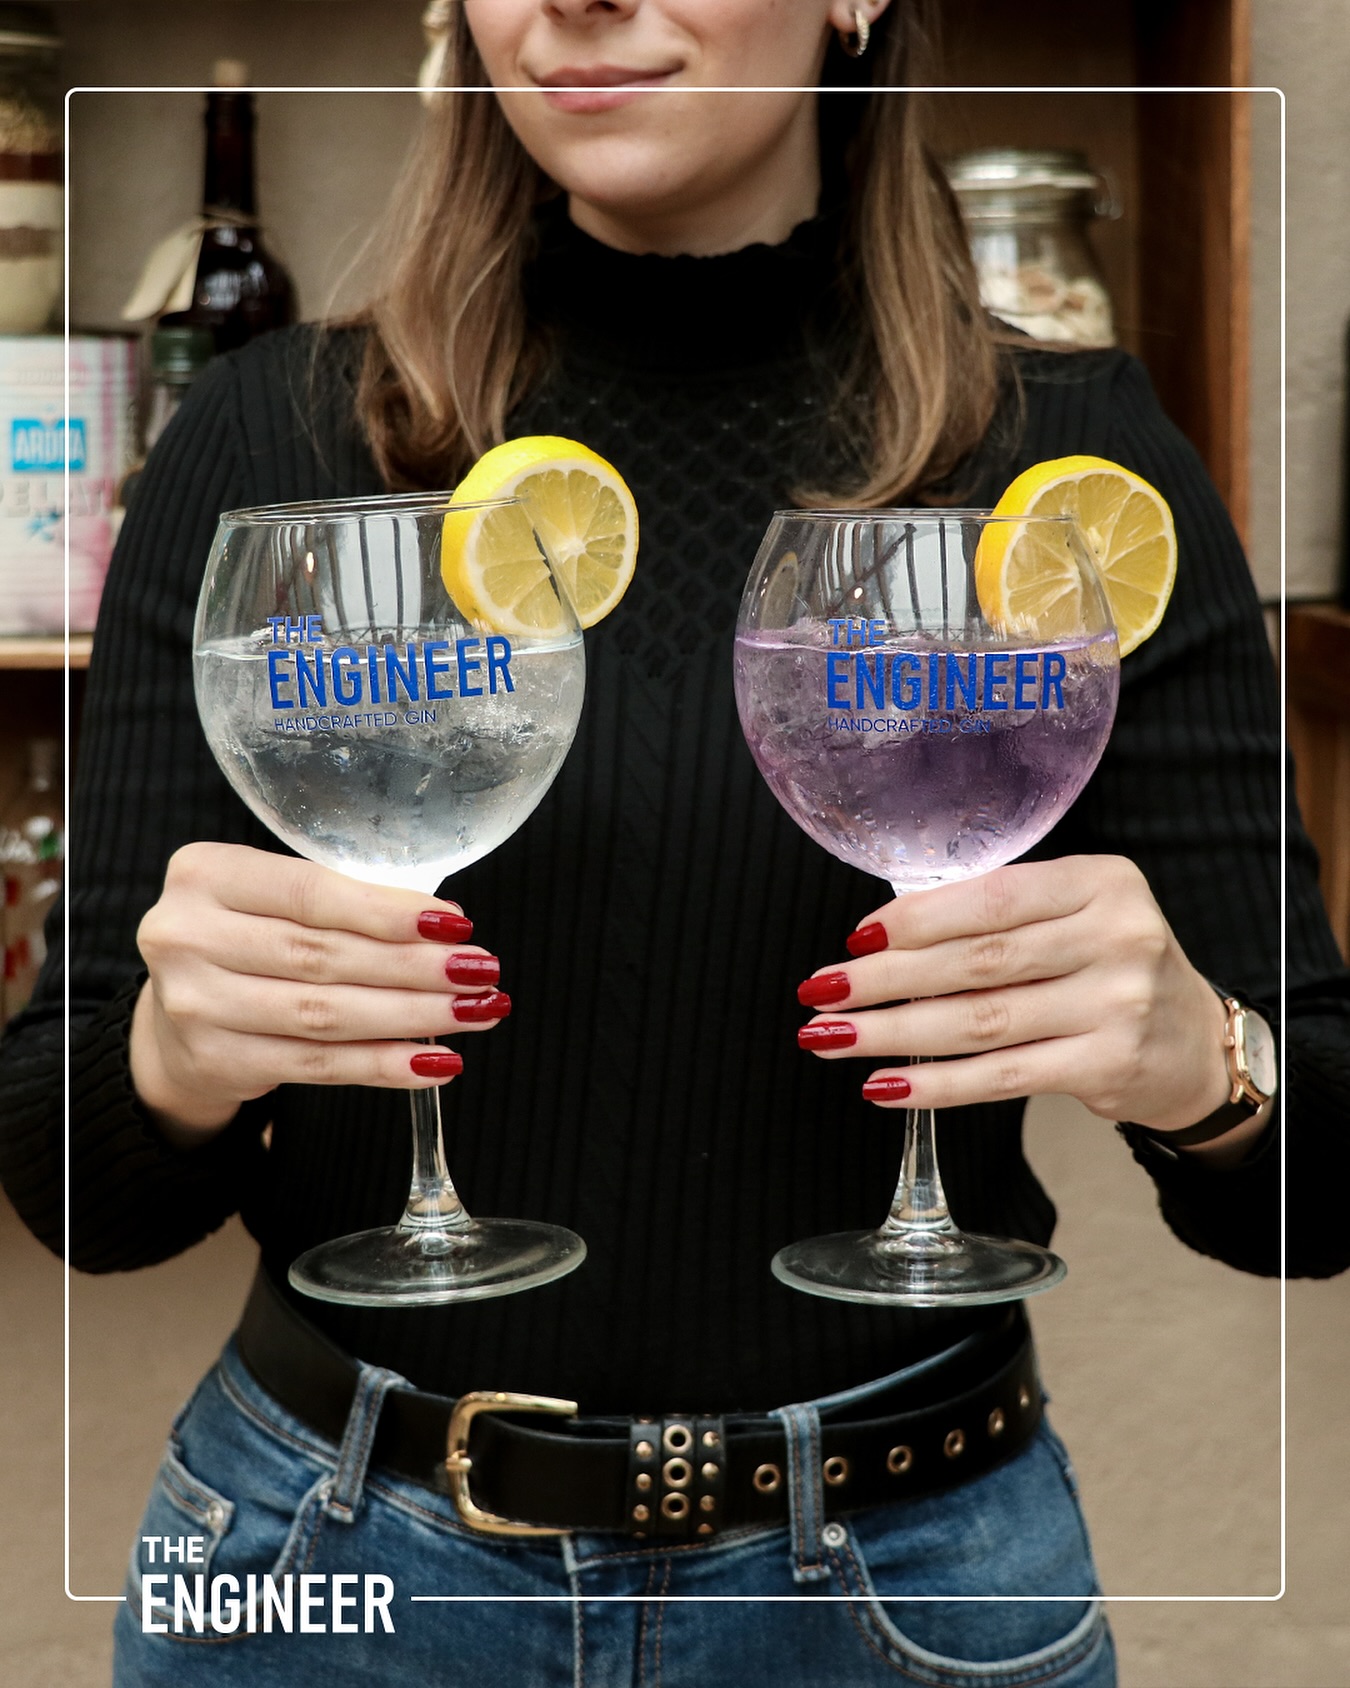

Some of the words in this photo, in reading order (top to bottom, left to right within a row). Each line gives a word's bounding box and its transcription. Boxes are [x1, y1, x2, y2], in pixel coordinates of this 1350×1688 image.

[267, 614, 323, 644] THE
[828, 619, 886, 646] THE
[267, 636, 515, 709] ENGINEER
[826, 652, 1066, 711] ENGINEER
[274, 711, 397, 731] HANDCRAFTED
[405, 709, 437, 725] GIN
[827, 716, 950, 734] HANDCRAFTED
[959, 718, 991, 734] GIN
